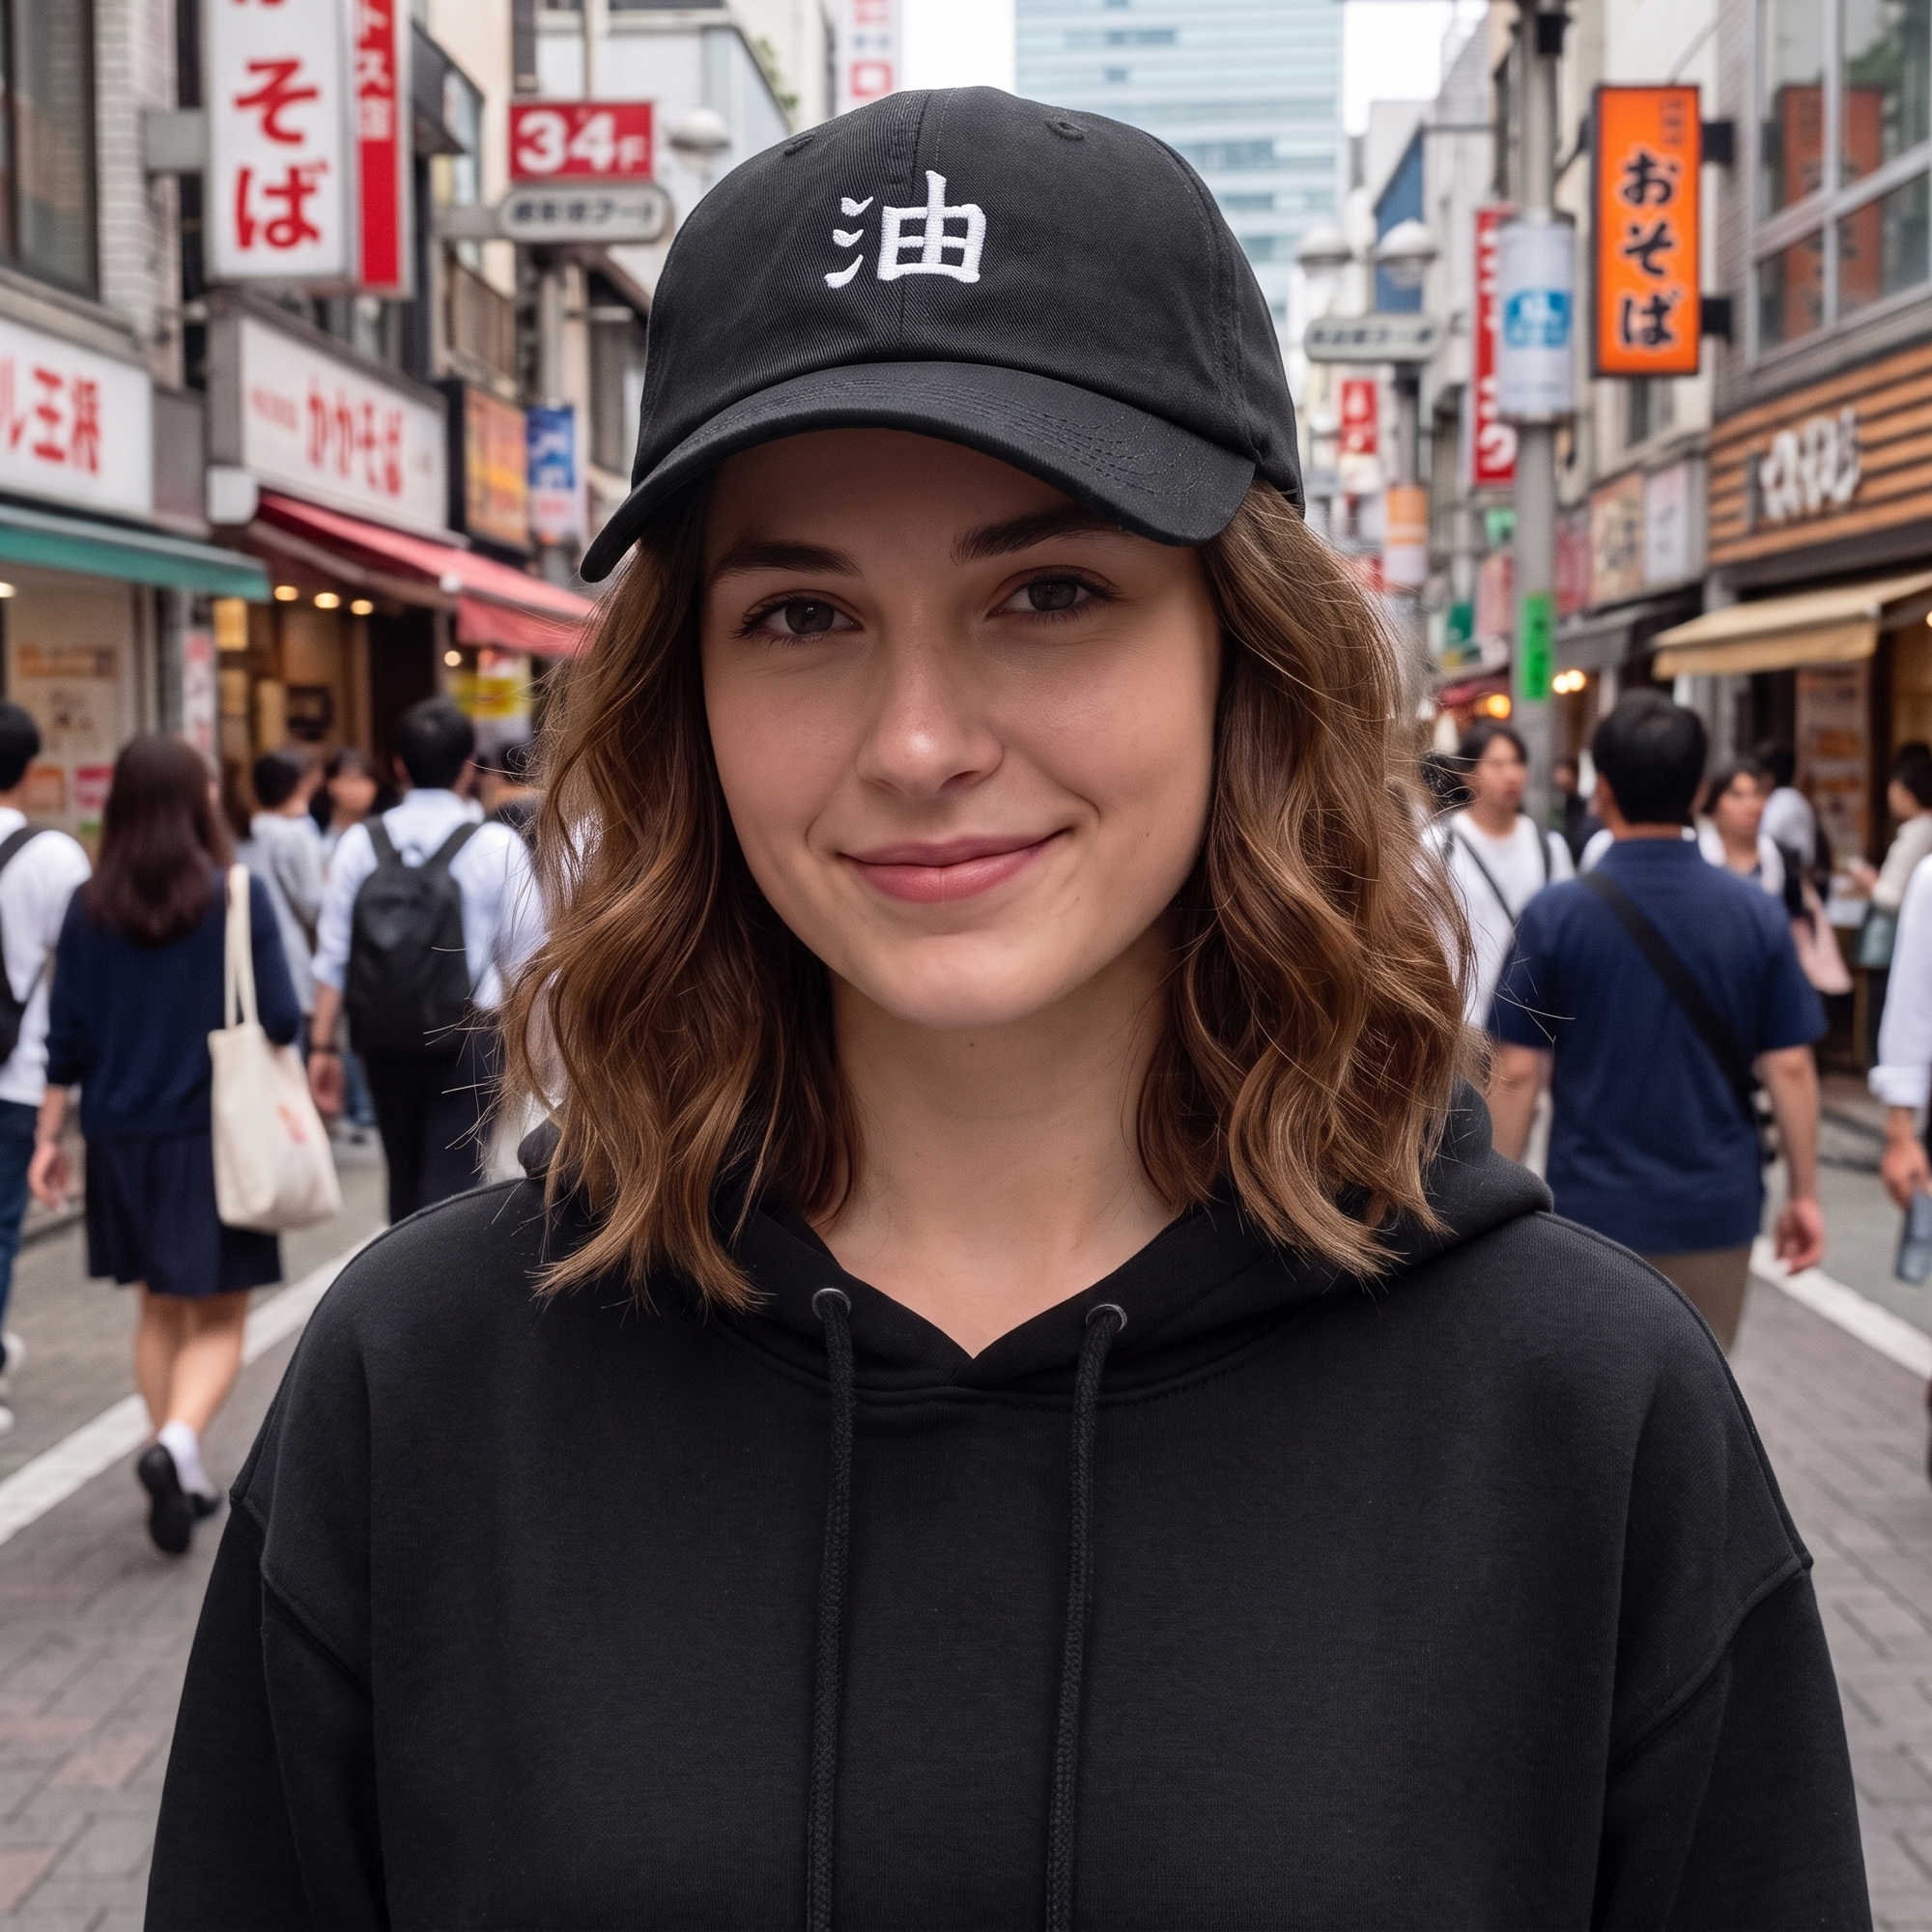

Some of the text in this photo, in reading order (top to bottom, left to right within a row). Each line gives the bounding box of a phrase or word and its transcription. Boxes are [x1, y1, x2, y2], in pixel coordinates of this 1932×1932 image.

[234, 0, 328, 252] そば
[823, 169, 987, 289] 油
[1622, 151, 1680, 347] おそば
